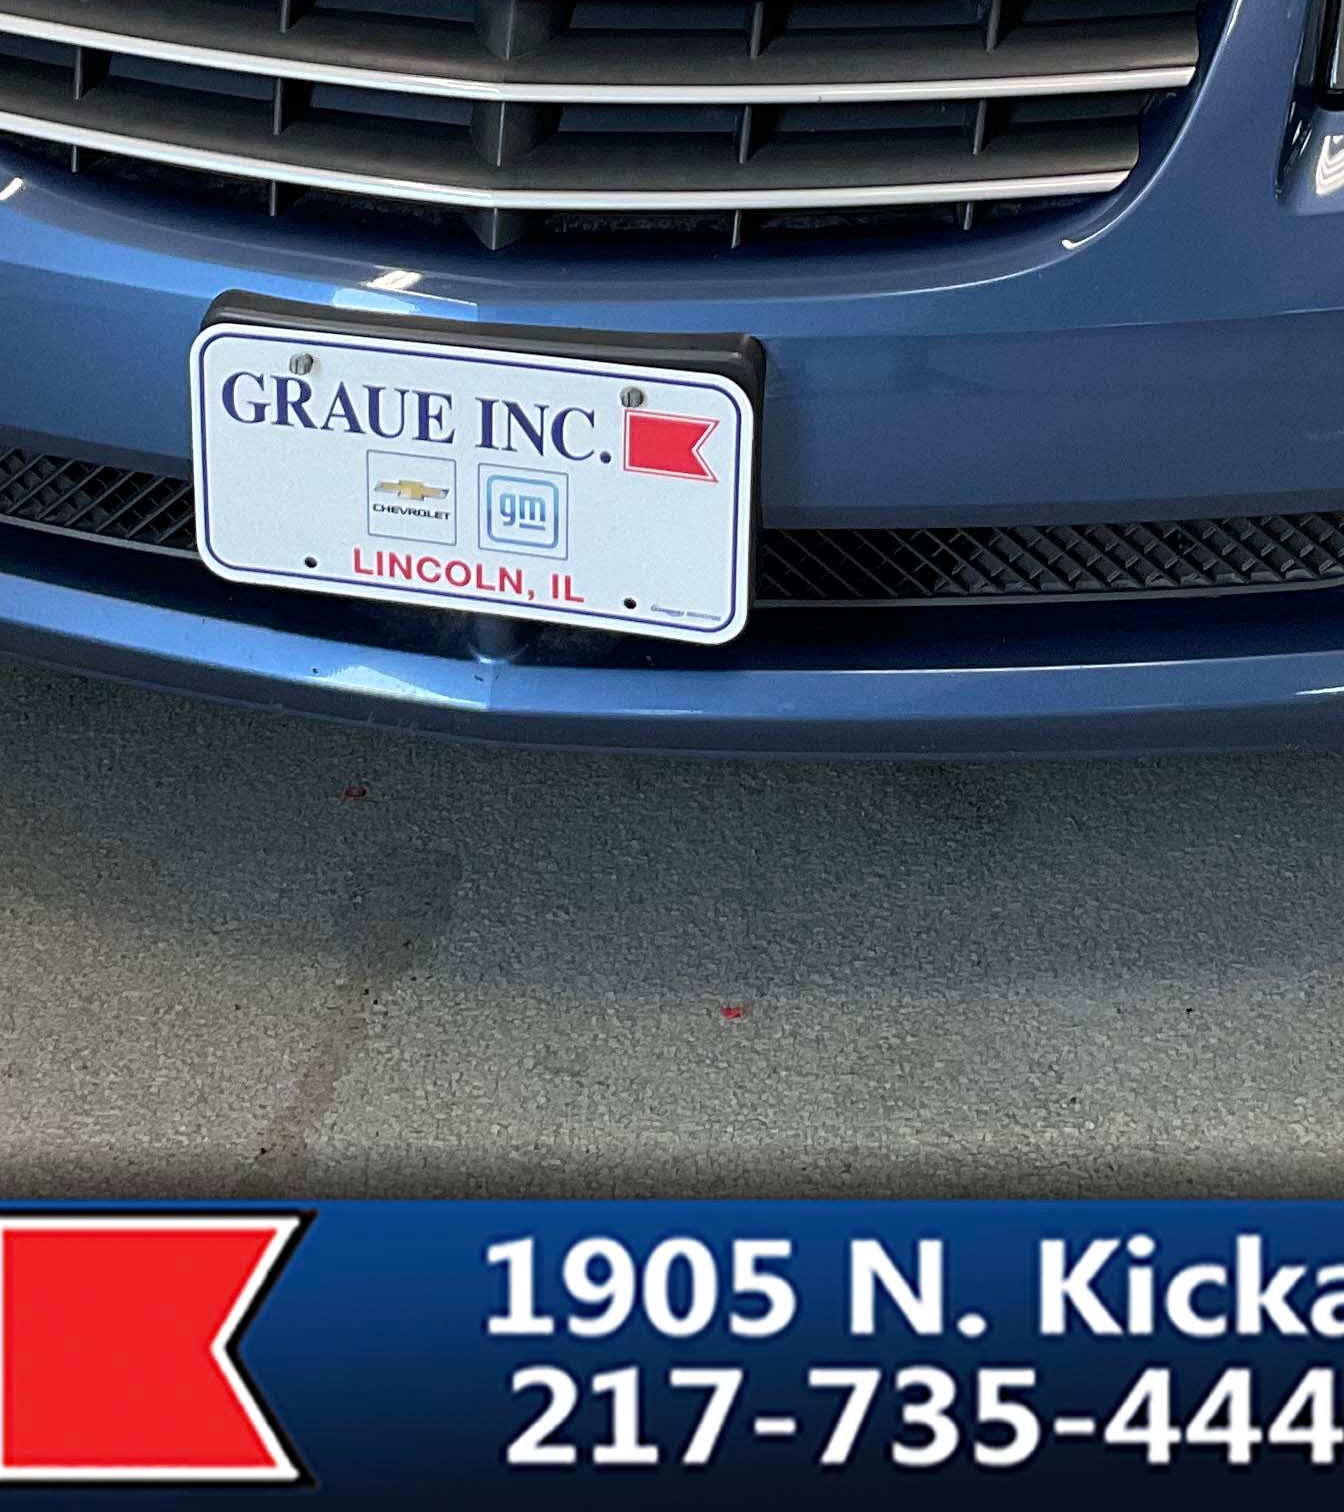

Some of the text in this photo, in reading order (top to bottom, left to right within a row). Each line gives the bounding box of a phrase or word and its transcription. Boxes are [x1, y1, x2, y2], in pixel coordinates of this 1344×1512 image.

[221, 371, 613, 465] GRAUE INC.
[372, 503, 451, 520] CHEVROLET
[499, 492, 547, 529] gm
[353, 548, 584, 603] LINCOLN, IL
